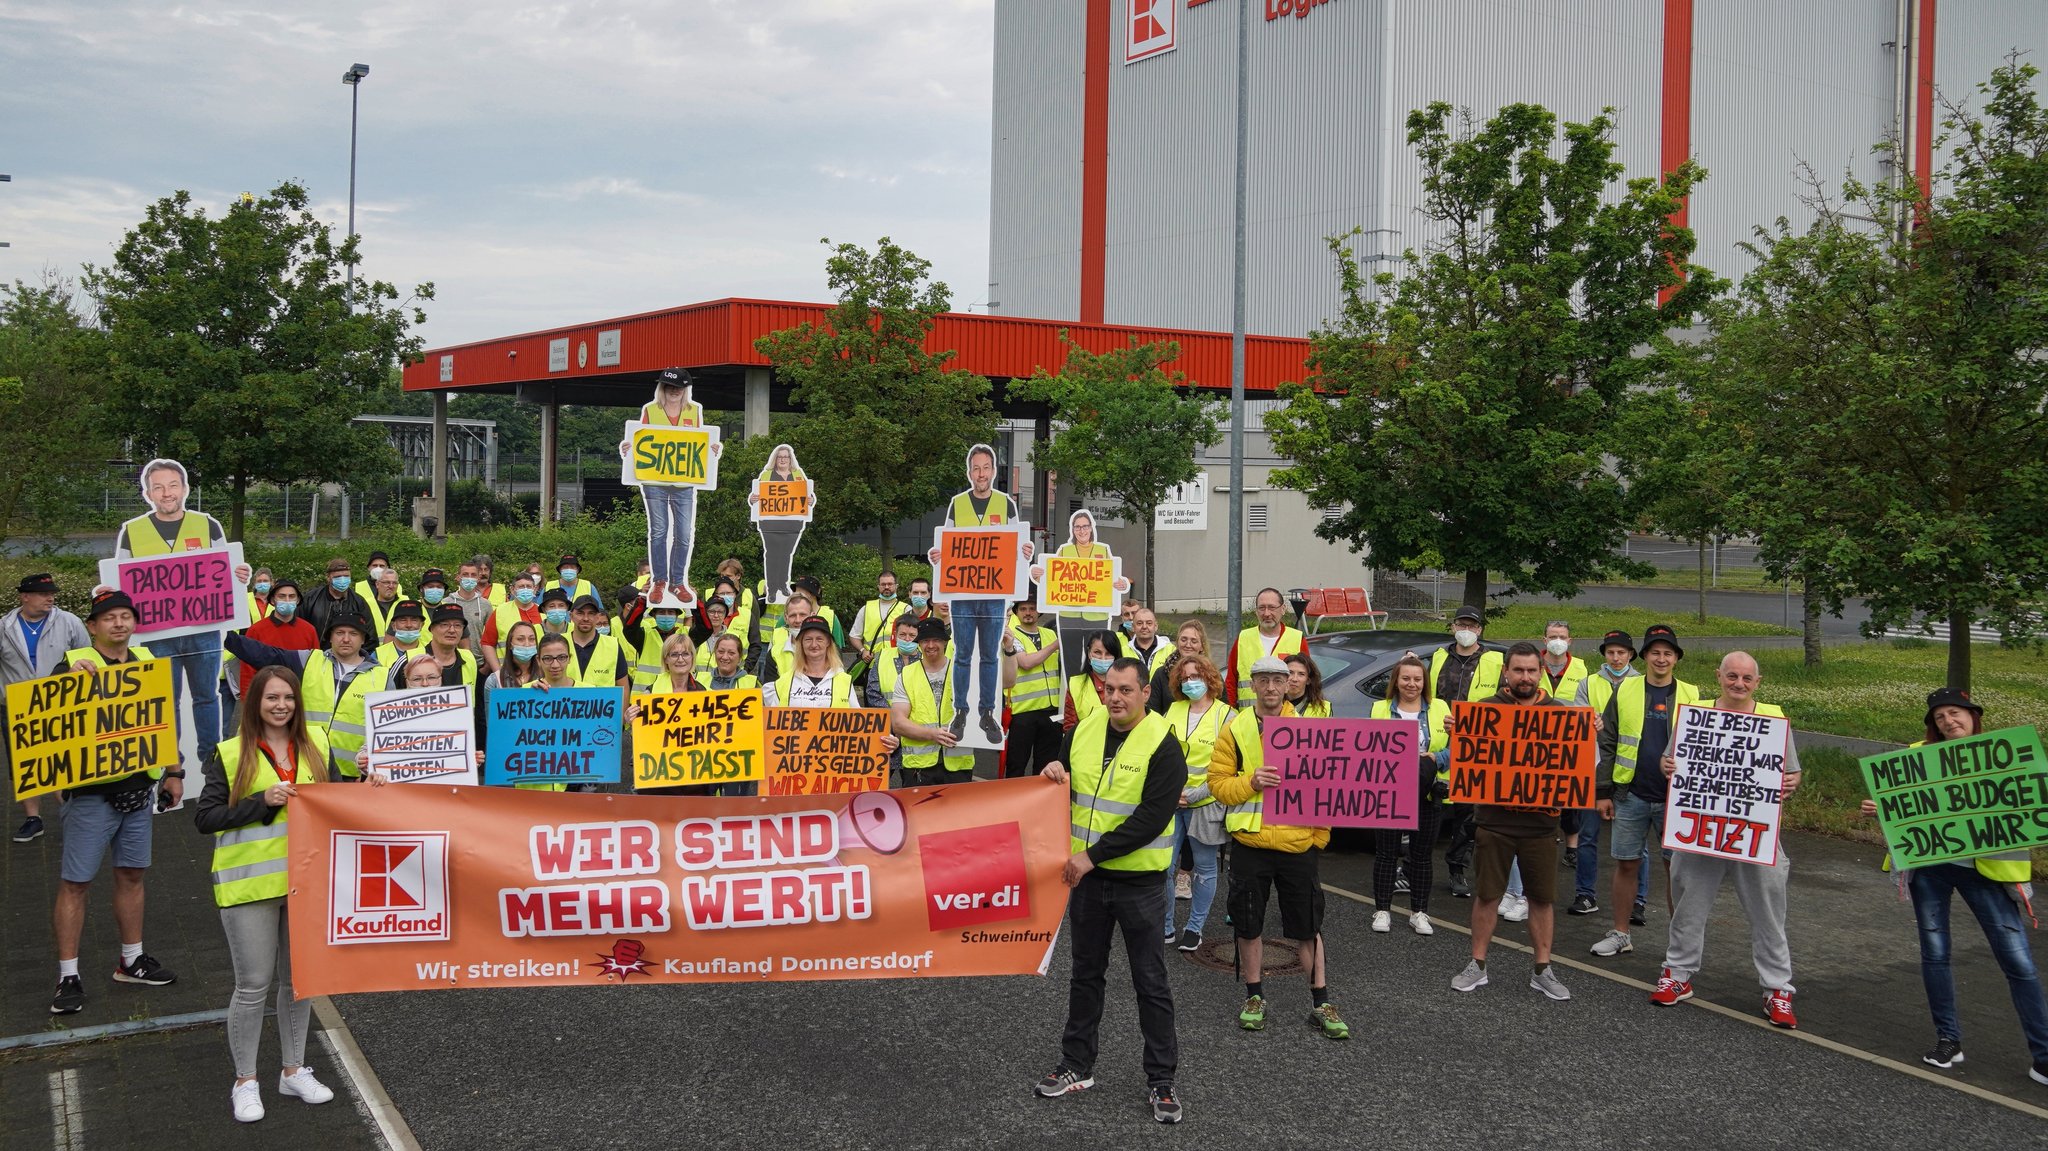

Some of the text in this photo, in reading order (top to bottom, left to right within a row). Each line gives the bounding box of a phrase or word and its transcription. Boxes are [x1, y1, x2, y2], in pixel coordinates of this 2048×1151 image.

[635, 435, 706, 479] STREIK
[768, 484, 789, 496] ES
[761, 497, 806, 513] REICHT!
[1174, 509, 1201, 517] LKW-Fahrer
[951, 536, 1001, 560] HEUTE
[945, 565, 1004, 590] STREIK
[1060, 582, 1088, 594] MEHR
[182, 591, 235, 622] KOHLE
[1051, 591, 1097, 604] KOHLE
[378, 693, 451, 724] ABWARTEN
[496, 698, 616, 720] WERTSCHÄTZUNG
[766, 710, 888, 733] LIEBE KUNDEN
[1686, 708, 1771, 735] DIE BESTE
[13, 696, 166, 750] REICHT NICHT
[663, 722, 734, 748] MEHR!
[1453, 704, 1592, 742] WIR HALTEN
[515, 728, 582, 747] AUCH IM
[773, 735, 871, 755] SIE ACHTEN
[1270, 727, 1409, 755] OHNE UNS
[1684, 728, 1761, 751] ZEIT ZU
[17, 734, 158, 794] ZUM LEBEN
[504, 750, 596, 775] GEHALT
[639, 748, 756, 781] DAS PASST
[830, 752, 889, 777] GELD?
[1456, 737, 1579, 770] DEN LADEN
[1676, 743, 1784, 773] STREIKEN WAR
[1120, 763, 1141, 773] ver.di
[1285, 754, 1400, 784] LÄUFT NIX
[1870, 752, 1928, 790] MEIN
[768, 775, 808, 796] WIR
[1452, 768, 1590, 808] AM LAUFEN
[1672, 774, 1782, 804] DIE ZWEITBESTE
[1879, 772, 2048, 823] MEIN BUDGET
[1274, 787, 1411, 820] IM HANDEL
[1675, 792, 1755, 817] ZEIT IST
[531, 811, 838, 879] WIR SIND
[1674, 810, 1770, 858] JETZT
[1906, 821, 1966, 858] DAS
[501, 866, 870, 936] MEHR WERT!
[933, 886, 1020, 911] ver.di
[336, 912, 442, 935] Kaufland
[961, 930, 1052, 944] Schweinfurt
[416, 950, 933, 980] Wir streiken! Kaufland Donnersdorf
